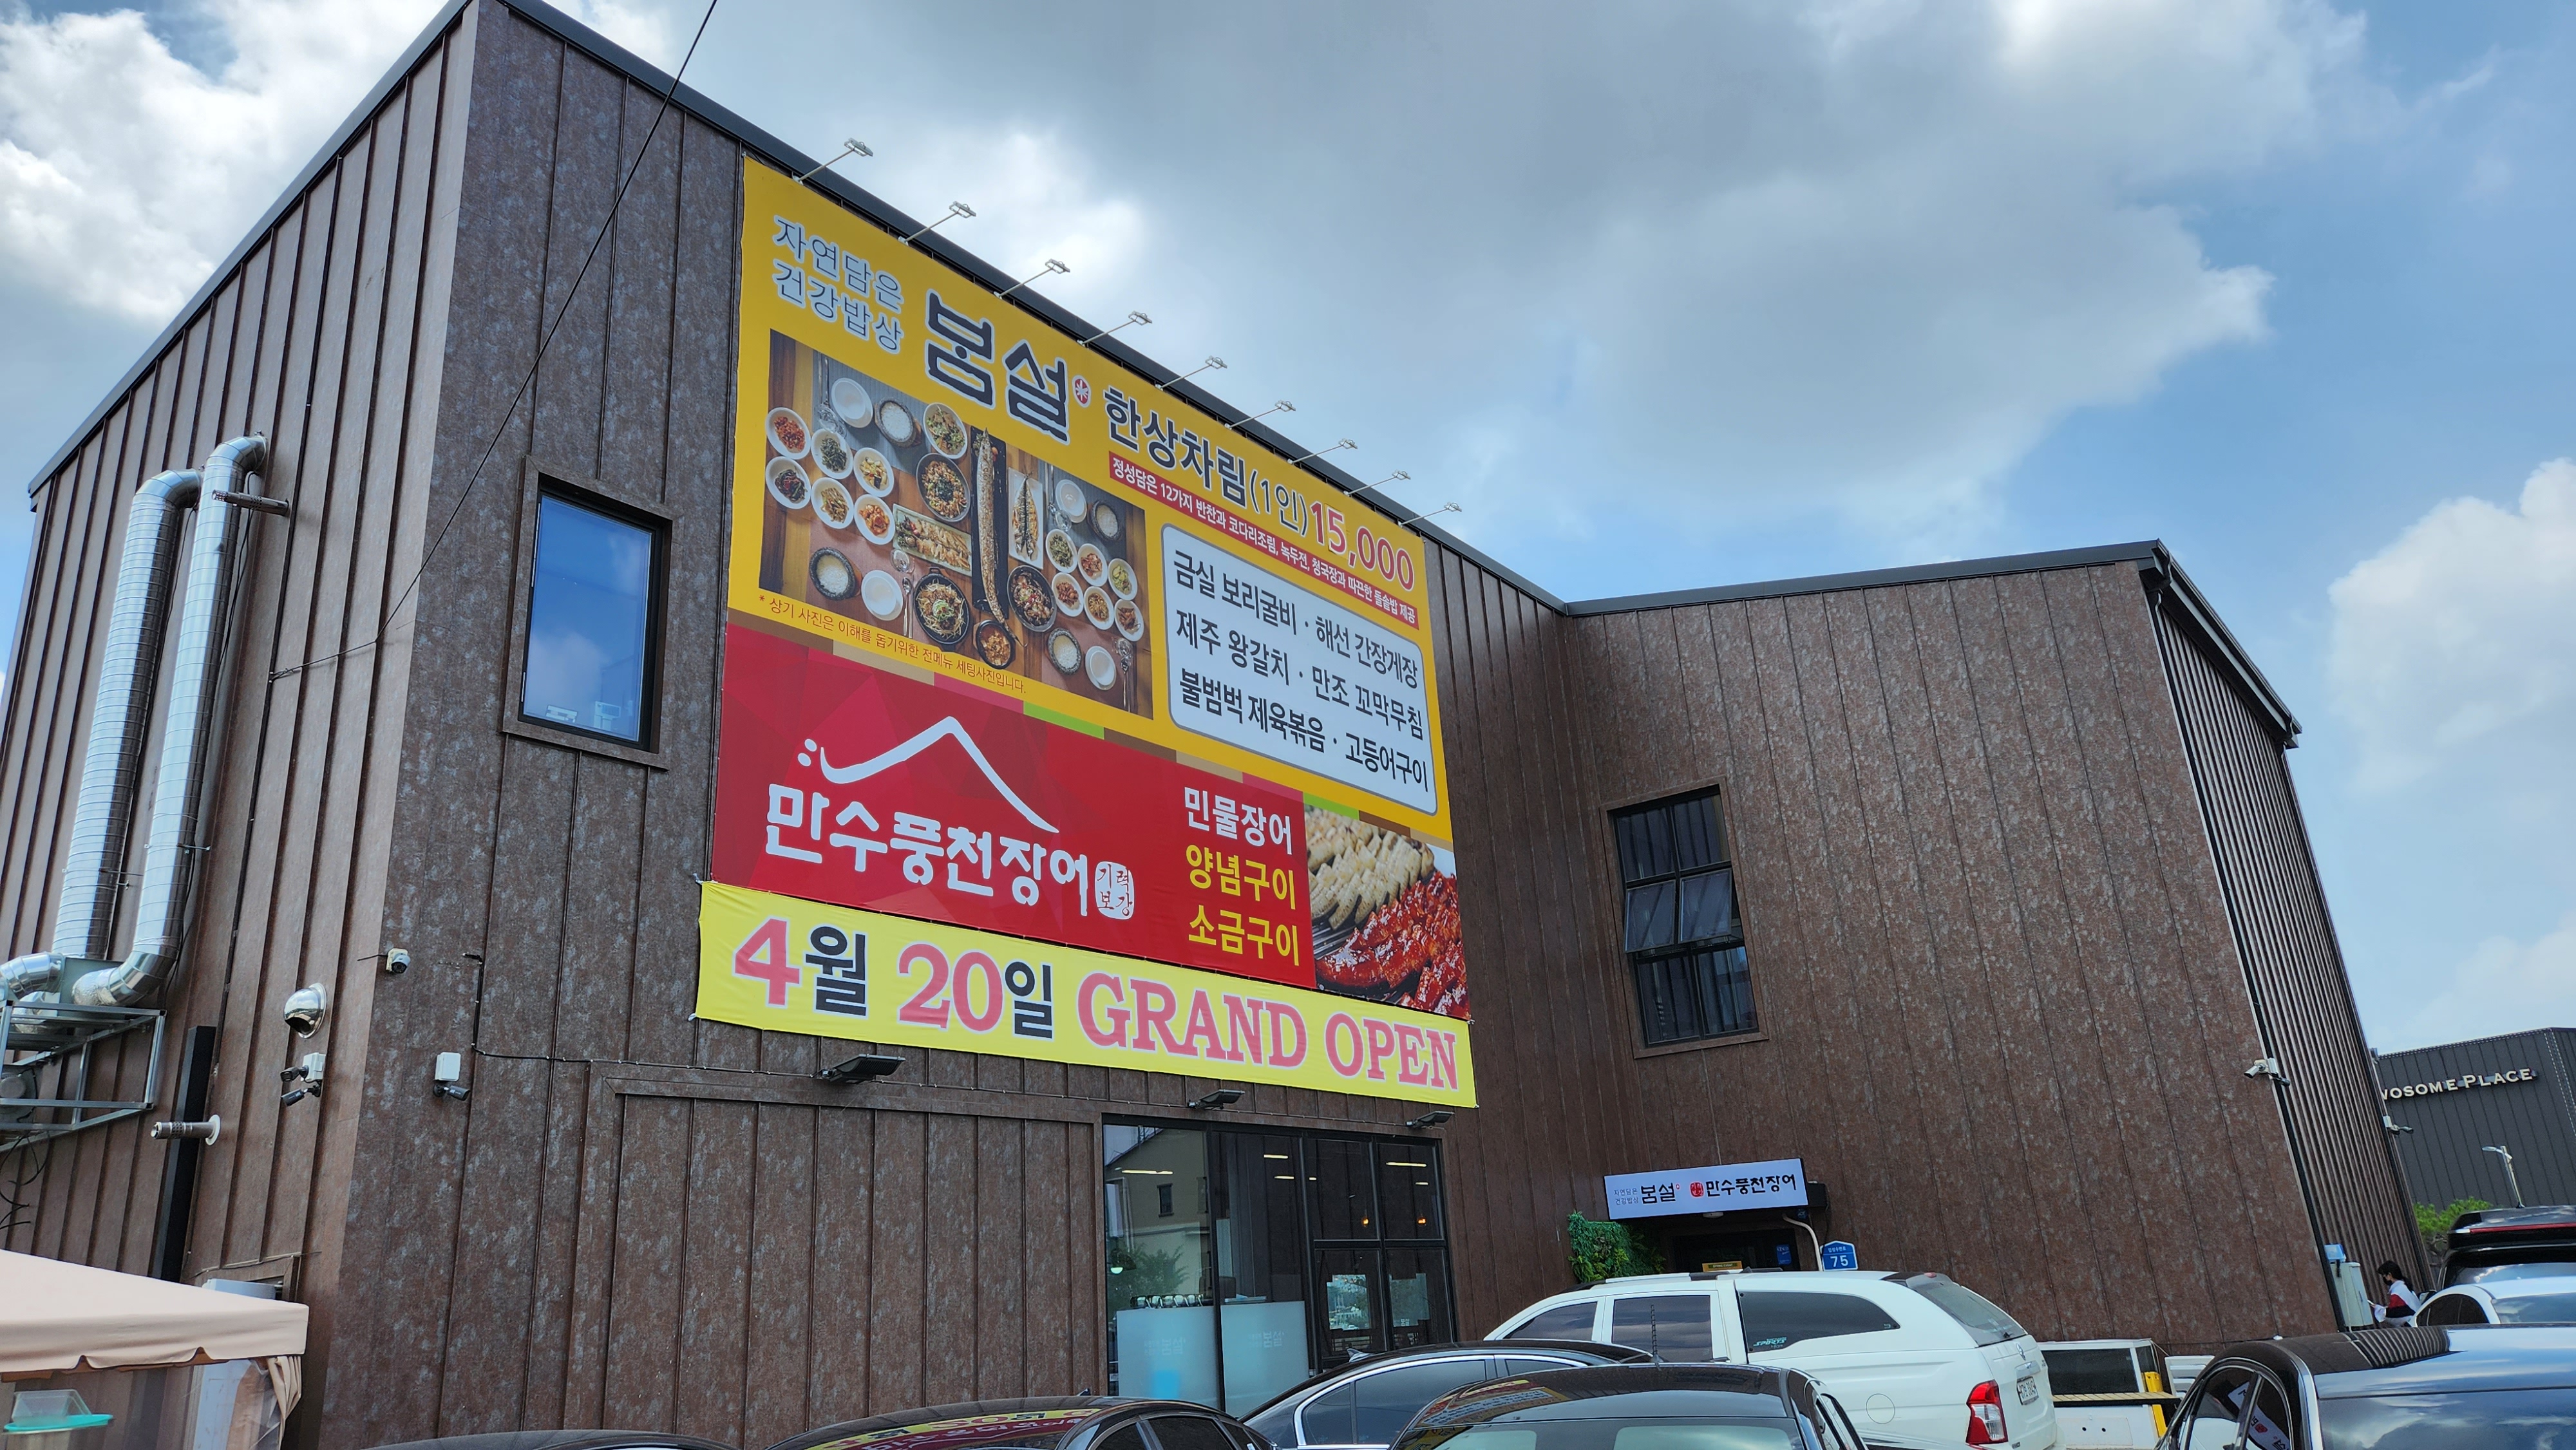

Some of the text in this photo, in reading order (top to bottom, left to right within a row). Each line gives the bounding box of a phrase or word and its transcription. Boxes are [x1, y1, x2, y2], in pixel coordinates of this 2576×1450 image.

[773, 214, 903, 312] 자연담은
[773, 259, 903, 355] 건강밥상
[925, 288, 1070, 445] 봄설
[1113, 457, 1416, 625] 정성담은 12가지 반찬과 코다리조림, 녹두전, 청국장과 따끈한 돌솥밥 제공
[1311, 501, 1414, 592] 15,000
[770, 598, 1027, 694] 상기 사진은 이해를 돕기위한 전메뉴 세팅사진입니다.
[1174, 550, 1417, 689] 금실 보리굴비 해선 간장게장
[1177, 610, 1423, 740] 제주 왕갈치 만조 꼬막무침
[1180, 668, 1428, 792] 불범벅 제육볶음 고등어구이
[766, 784, 1088, 916] 만수풍천장어
[1184, 787, 1293, 855] 민물장어
[1186, 845, 1296, 910] 양념구이
[1189, 905, 1299, 966] 소금구이
[733, 917, 1458, 1090] 4월 20일 GRAND OPEN
[2463, 1068, 2533, 1088] PLACE
[1614, 1187, 1638, 1196] 자연담은
[1615, 1197, 1639, 1205] 건강밥상
[1641, 1182, 1676, 1204] 봄설
[1705, 1174, 1797, 1197] 만수풍천장어
[1830, 1255, 1848, 1268] 75
